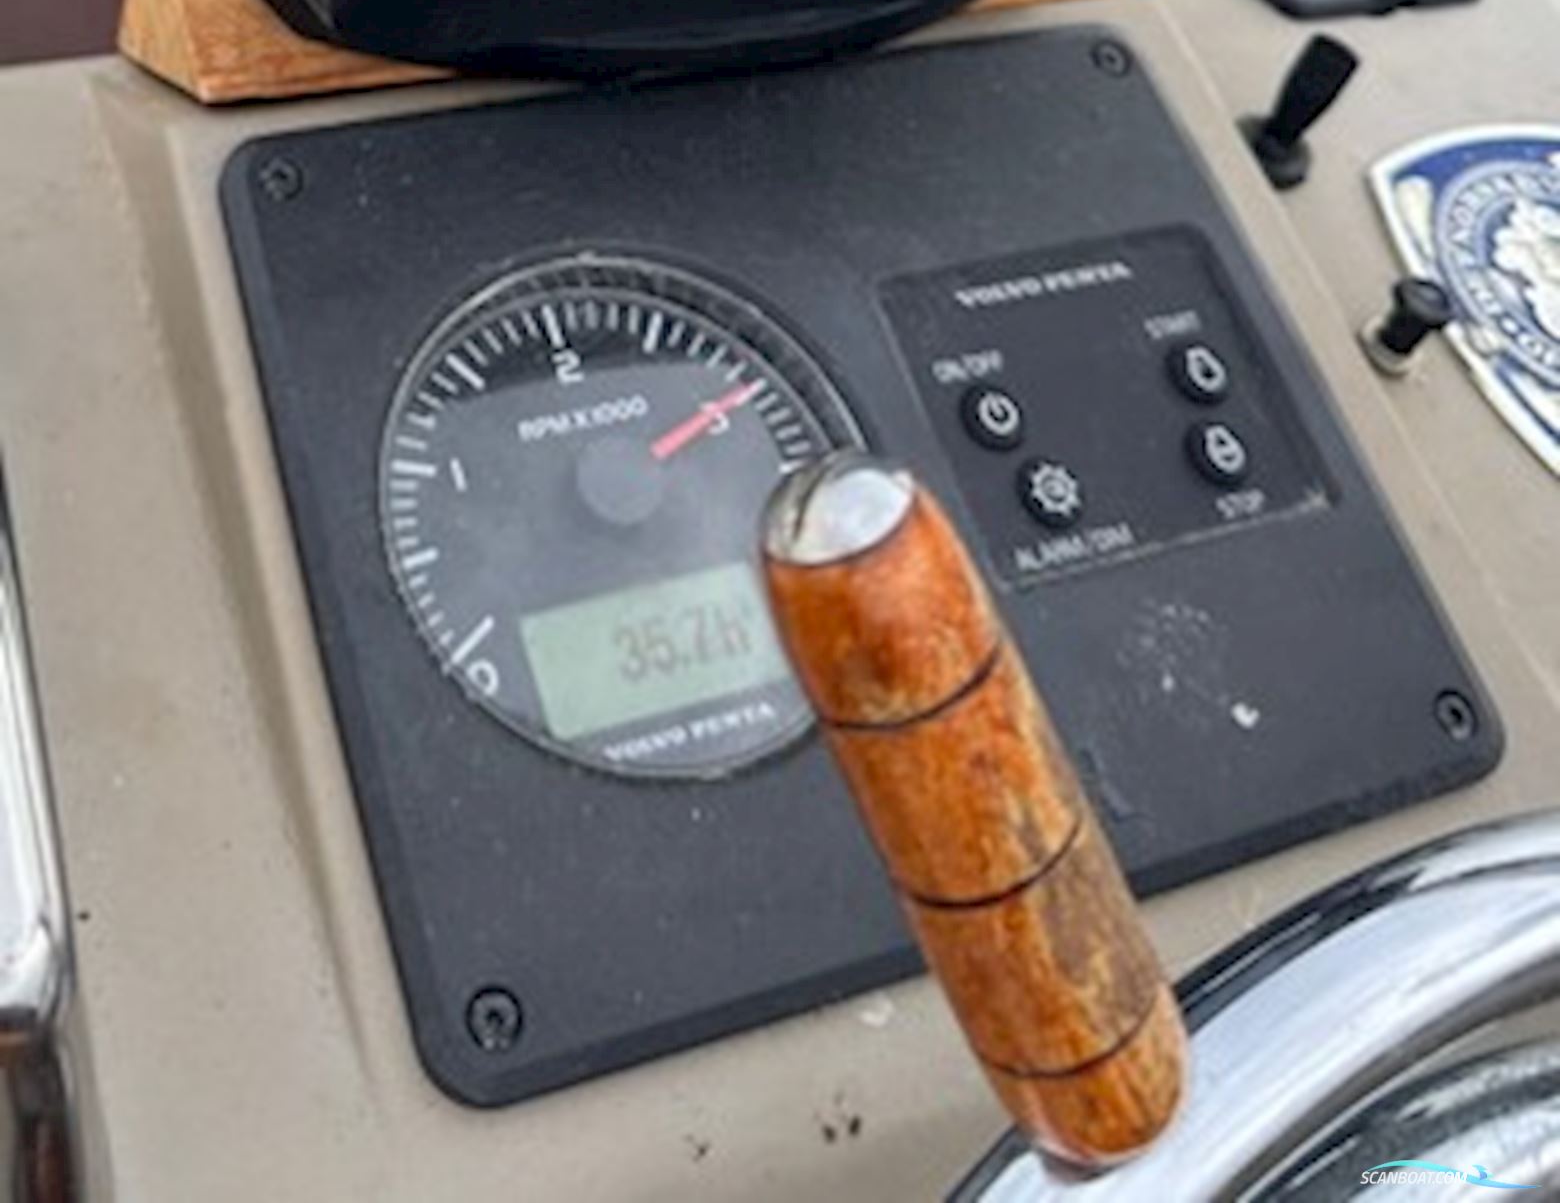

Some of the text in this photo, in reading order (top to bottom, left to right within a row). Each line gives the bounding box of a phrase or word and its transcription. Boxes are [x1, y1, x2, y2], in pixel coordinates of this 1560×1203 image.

[954, 261, 1132, 308] VOLVO PENTA
[1144, 309, 1200, 339] START
[553, 350, 585, 384] 2
[451, 457, 467, 492] 1
[1215, 489, 1265, 519] STOP
[465, 658, 499, 696] 0
[603, 701, 776, 762] VOLVO PENTA
